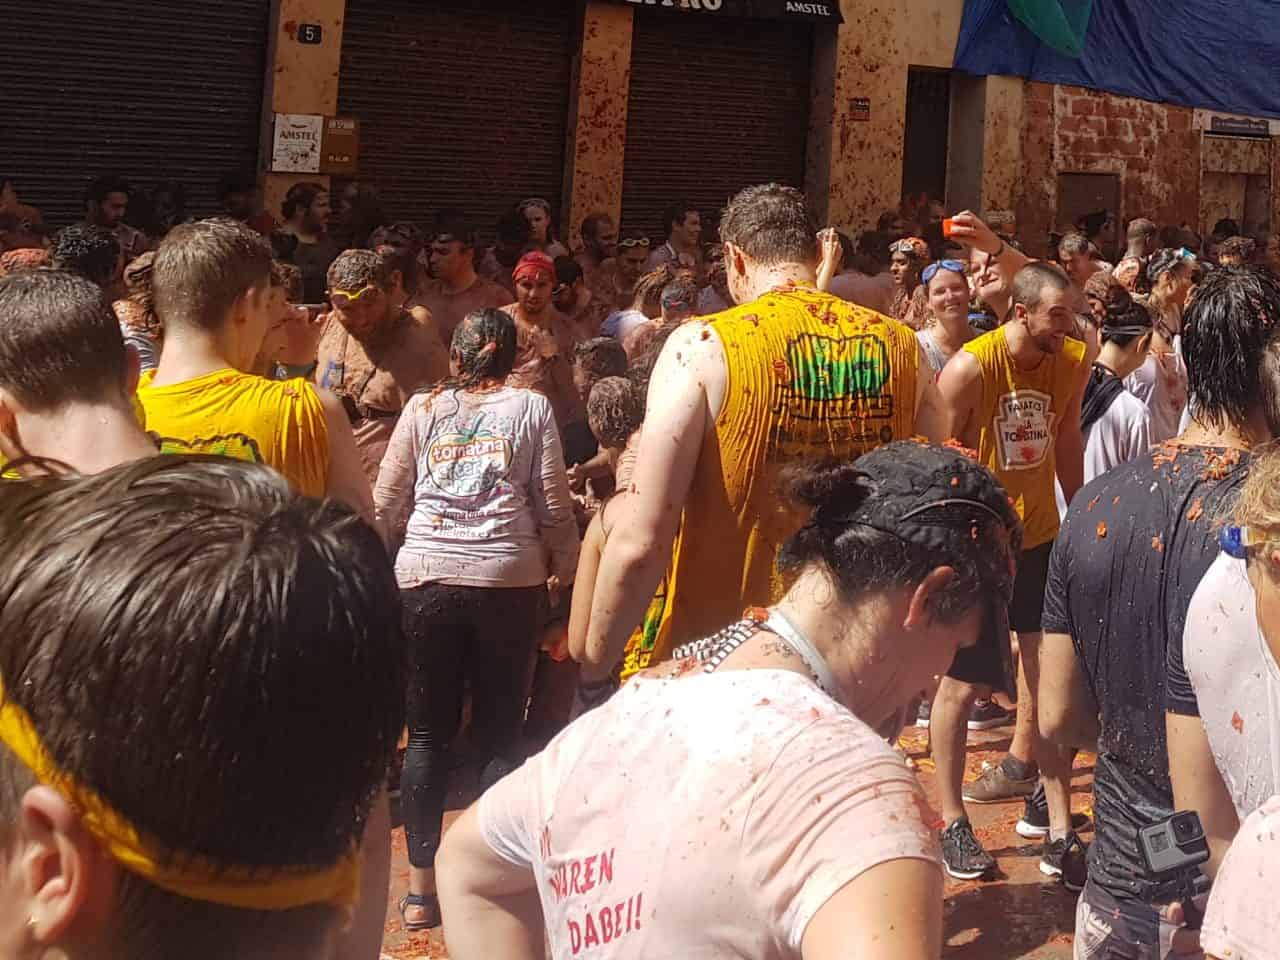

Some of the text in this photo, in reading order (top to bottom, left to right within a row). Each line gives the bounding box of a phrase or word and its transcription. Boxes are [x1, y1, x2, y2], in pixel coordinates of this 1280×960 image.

[785, 1, 831, 16] AMSTEL
[305, 26, 314, 41] 5
[432, 440, 504, 462] tomatina
[567, 891, 643, 955] DABEI!
